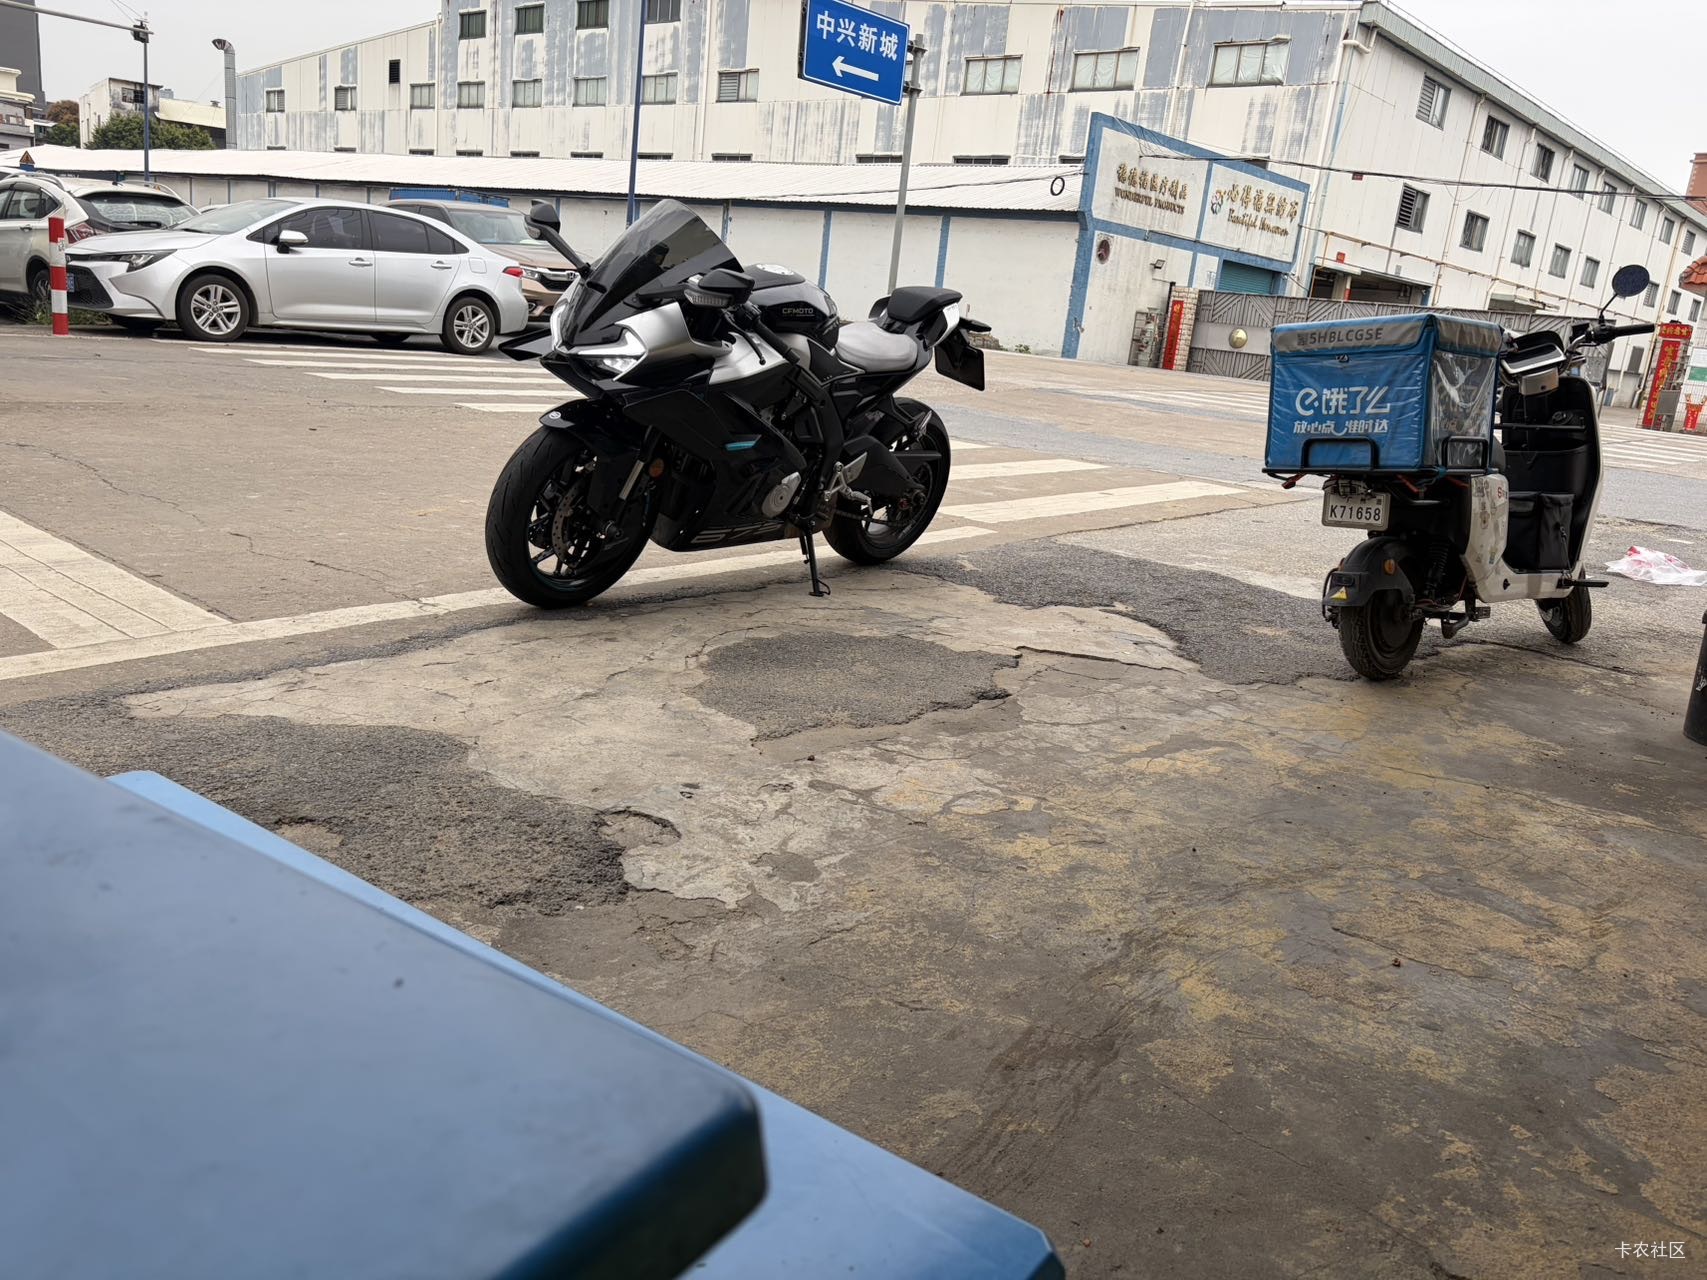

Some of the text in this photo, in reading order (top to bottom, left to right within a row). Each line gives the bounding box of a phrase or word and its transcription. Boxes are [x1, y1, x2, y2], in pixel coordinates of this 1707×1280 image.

[817, 11, 898, 61] 中兴新城
[1154, 199, 1185, 215] PRODUCTS
[1322, 386, 1391, 415] 饿了么
[1329, 504, 1381, 521] K71658
